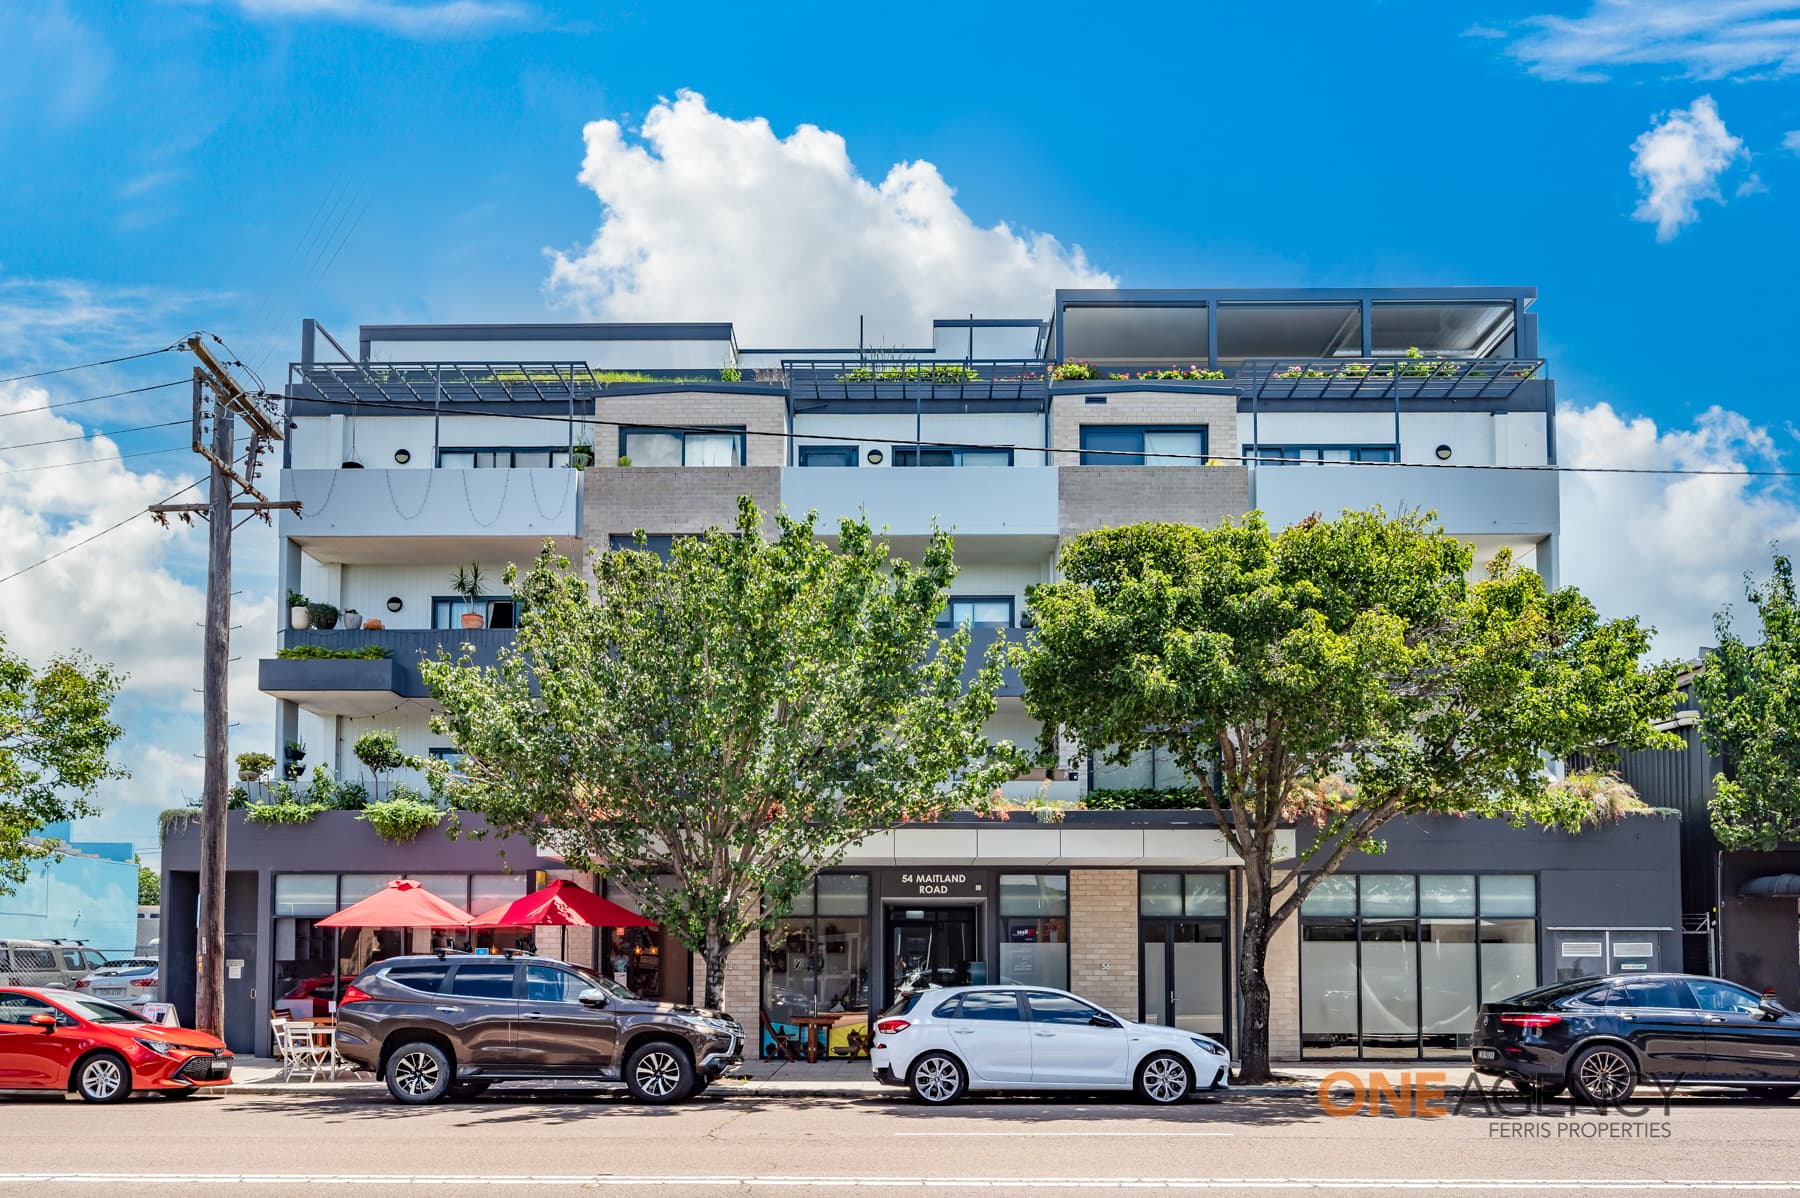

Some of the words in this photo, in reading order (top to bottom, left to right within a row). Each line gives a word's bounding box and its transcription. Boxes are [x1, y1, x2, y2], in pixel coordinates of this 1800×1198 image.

[902, 875, 913, 883] 54
[916, 875, 966, 883] MAITLAND
[919, 885, 948, 894] ROAD
